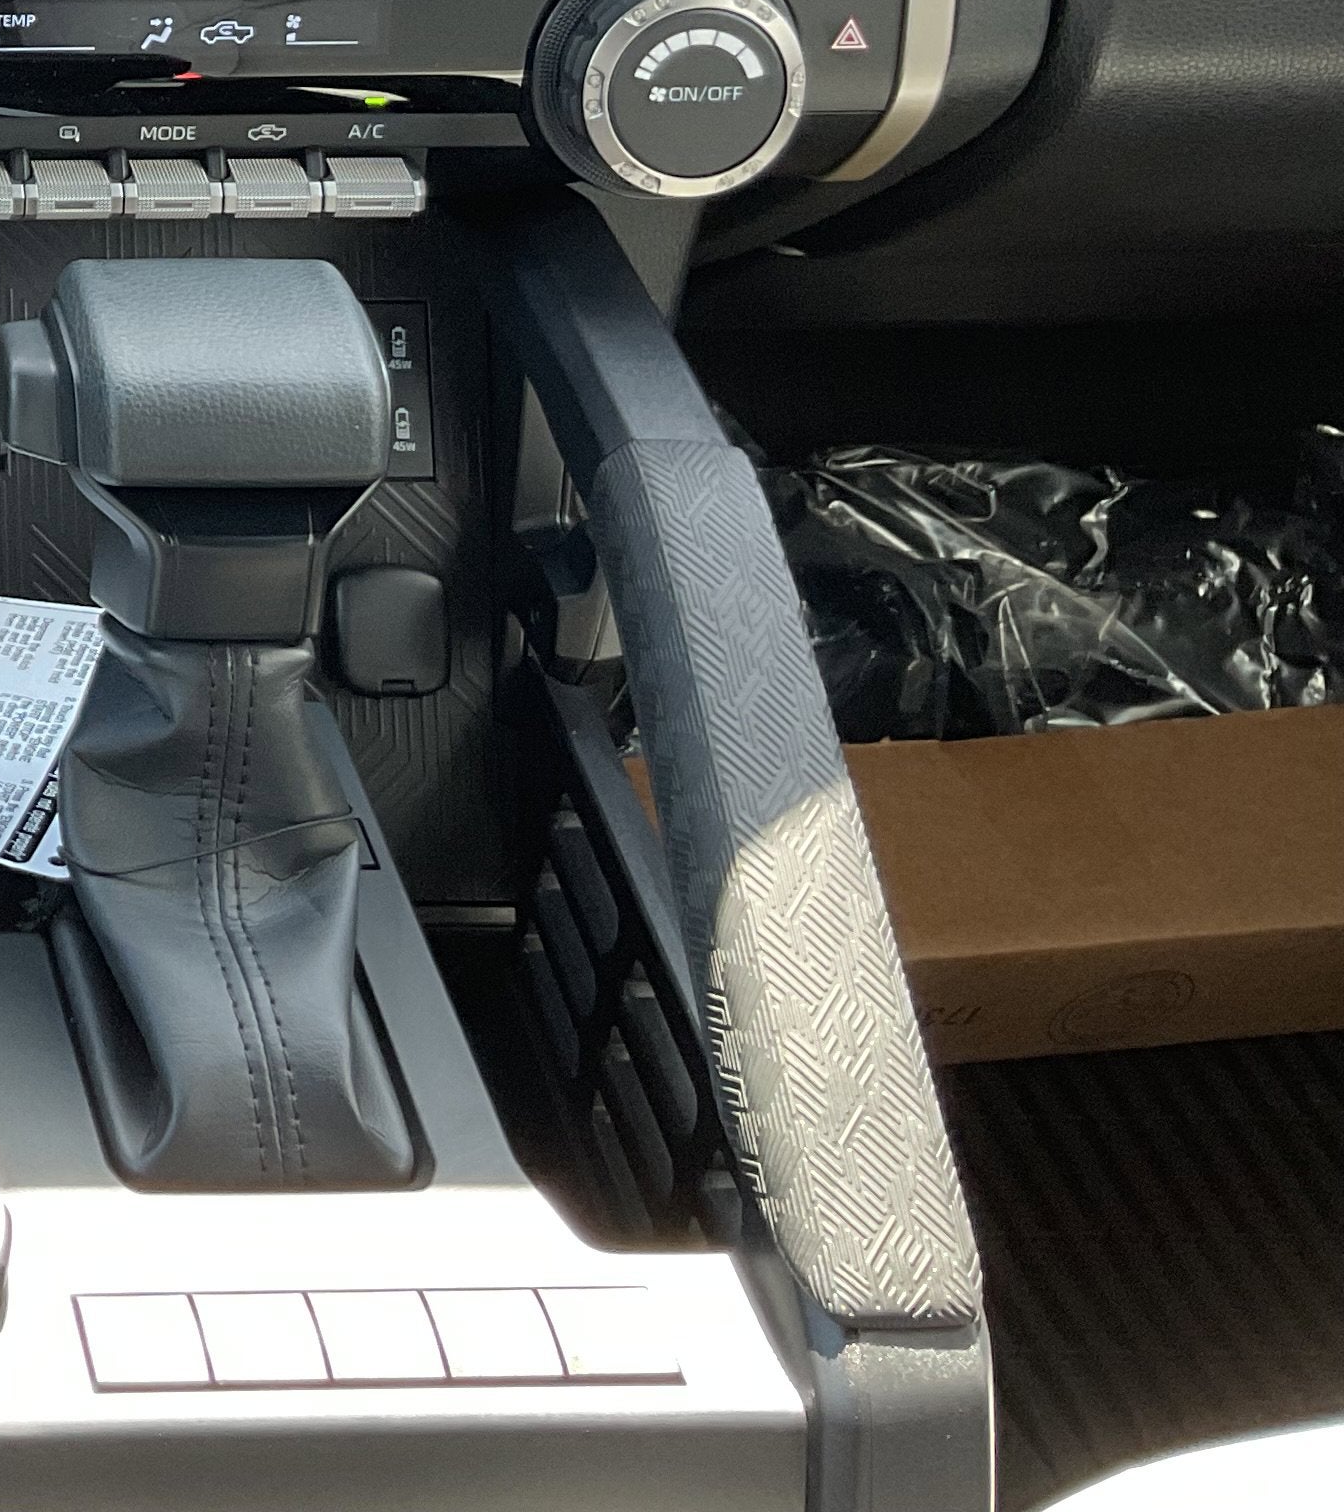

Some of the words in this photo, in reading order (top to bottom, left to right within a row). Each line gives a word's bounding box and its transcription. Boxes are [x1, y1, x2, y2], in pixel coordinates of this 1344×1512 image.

[668, 86, 744, 102] ON/OFF
[139, 126, 197, 142] MODE
[347, 123, 385, 140] A/C
[387, 358, 413, 370] 45W
[392, 441, 417, 453] 45W
